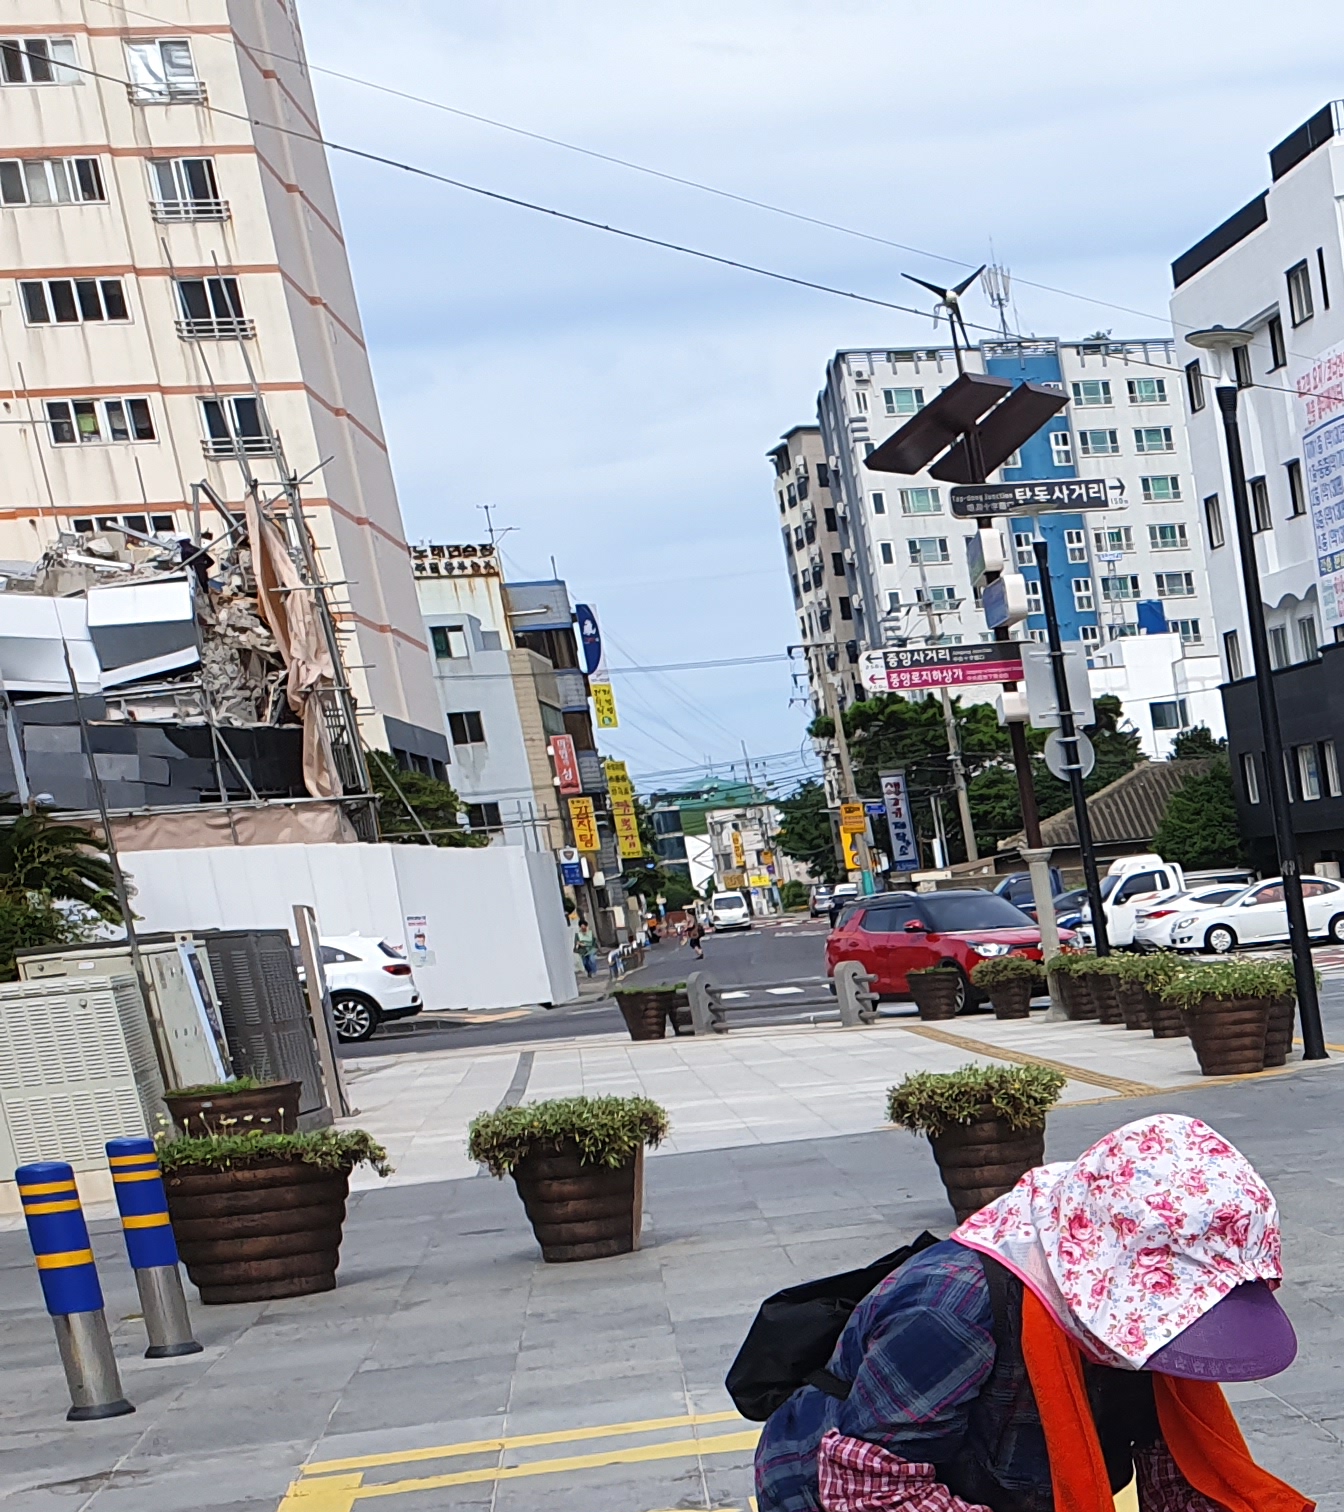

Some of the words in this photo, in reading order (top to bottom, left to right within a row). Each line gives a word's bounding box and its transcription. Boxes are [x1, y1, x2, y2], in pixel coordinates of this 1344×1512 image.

[885, 648, 950, 667] 중앙사거리
[889, 668, 964, 687] 중앙로지하상가
[573, 804, 594, 849] 감자탕
